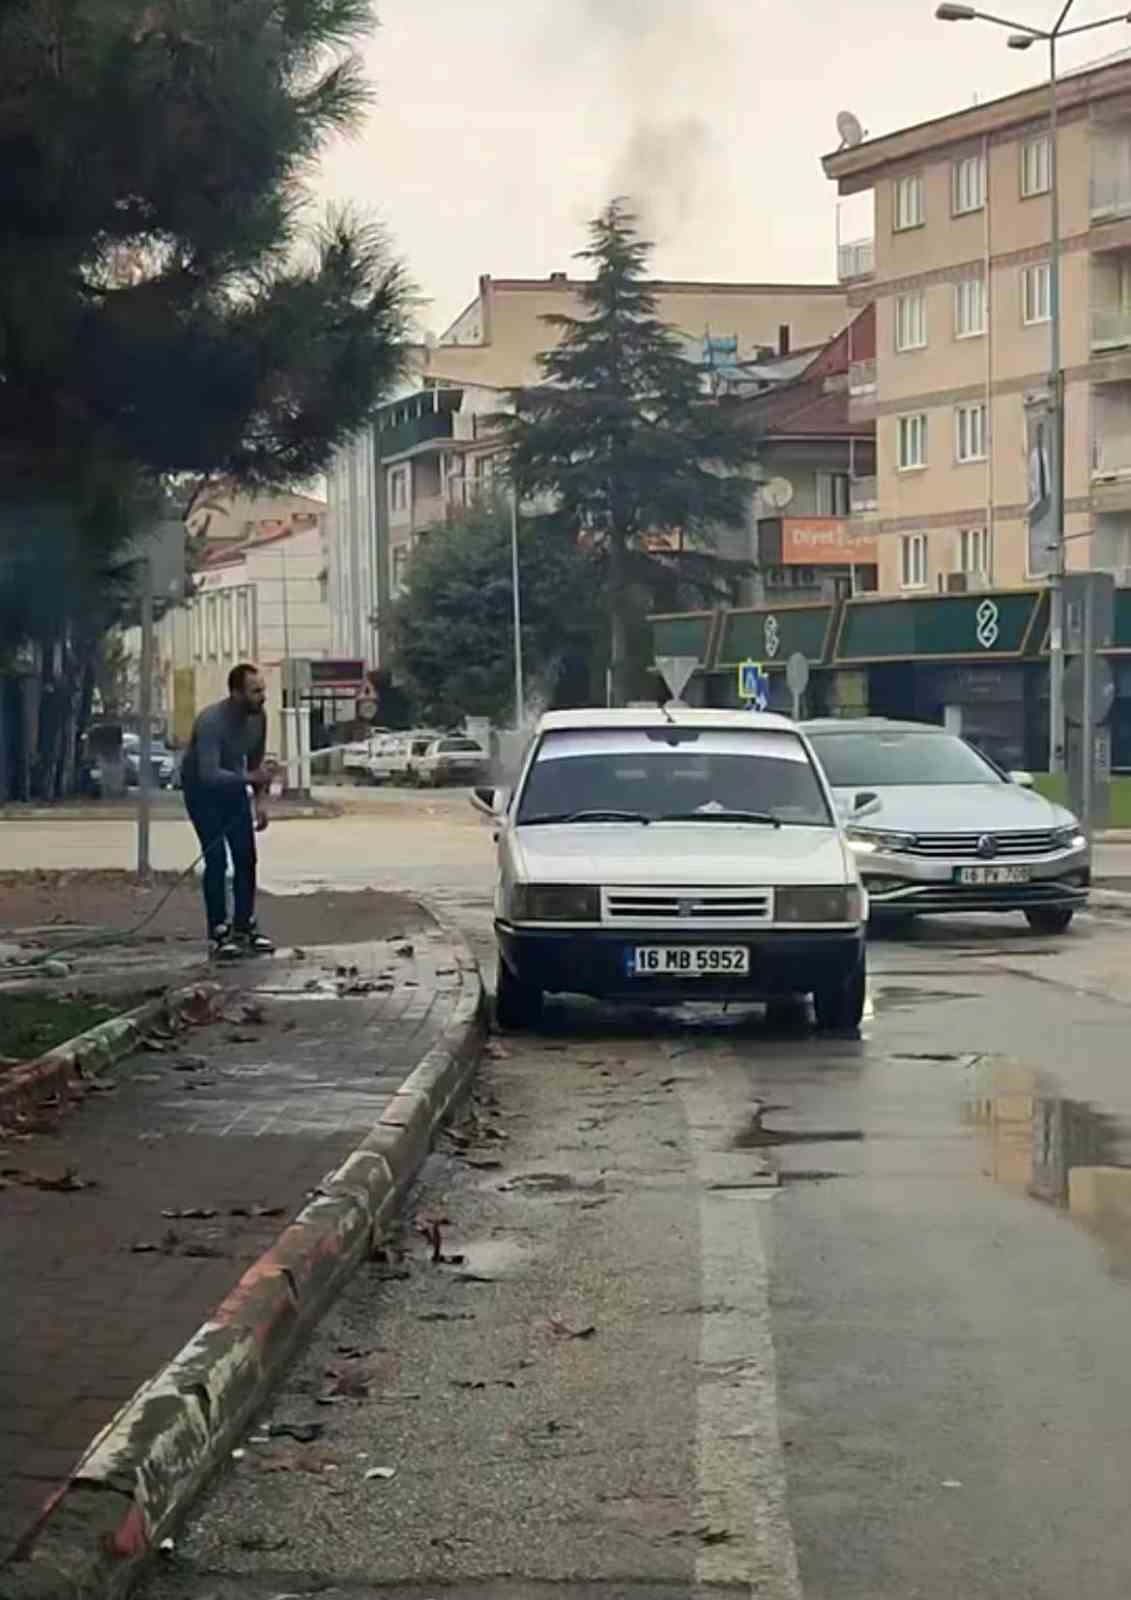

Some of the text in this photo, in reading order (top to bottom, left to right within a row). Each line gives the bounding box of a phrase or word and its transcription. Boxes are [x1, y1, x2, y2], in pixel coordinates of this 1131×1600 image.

[639, 950, 659, 969] 16
[666, 950, 691, 969] MB
[696, 950, 745, 969] 5952
